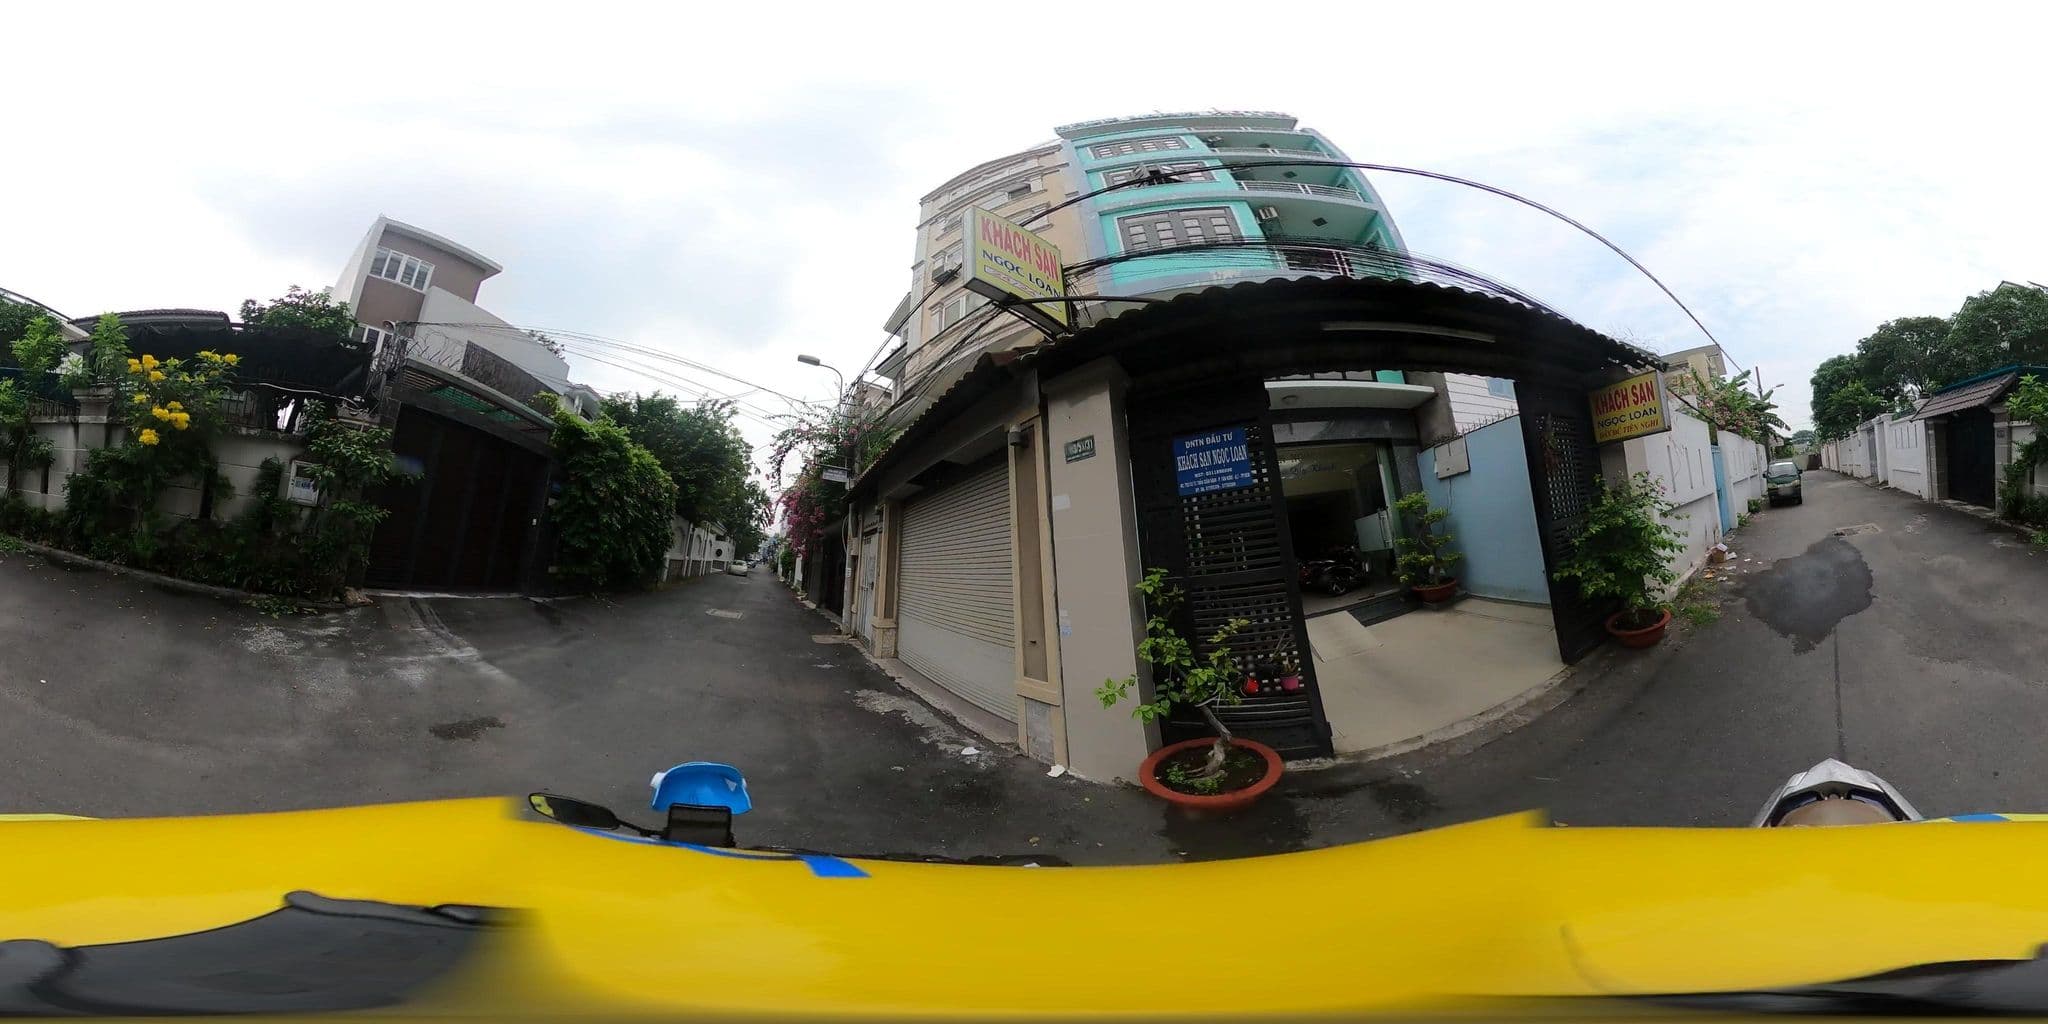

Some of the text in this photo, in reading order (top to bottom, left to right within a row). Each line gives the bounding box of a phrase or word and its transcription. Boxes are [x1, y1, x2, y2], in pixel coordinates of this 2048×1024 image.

[981, 215, 1059, 283] KHÁCH SẠN
[982, 249, 1024, 277] NGỌC
[1029, 273, 1061, 298] LOAN
[1594, 380, 1656, 417] KHÁCH SẠN
[1598, 407, 1657, 428] NGỌC LOAN
[1176, 450, 1199, 471] KHÁCH
[1212, 447, 1231, 467] NGỌC
[1230, 444, 1248, 462] LOAN
[1185, 438, 1205, 449] DNTN
